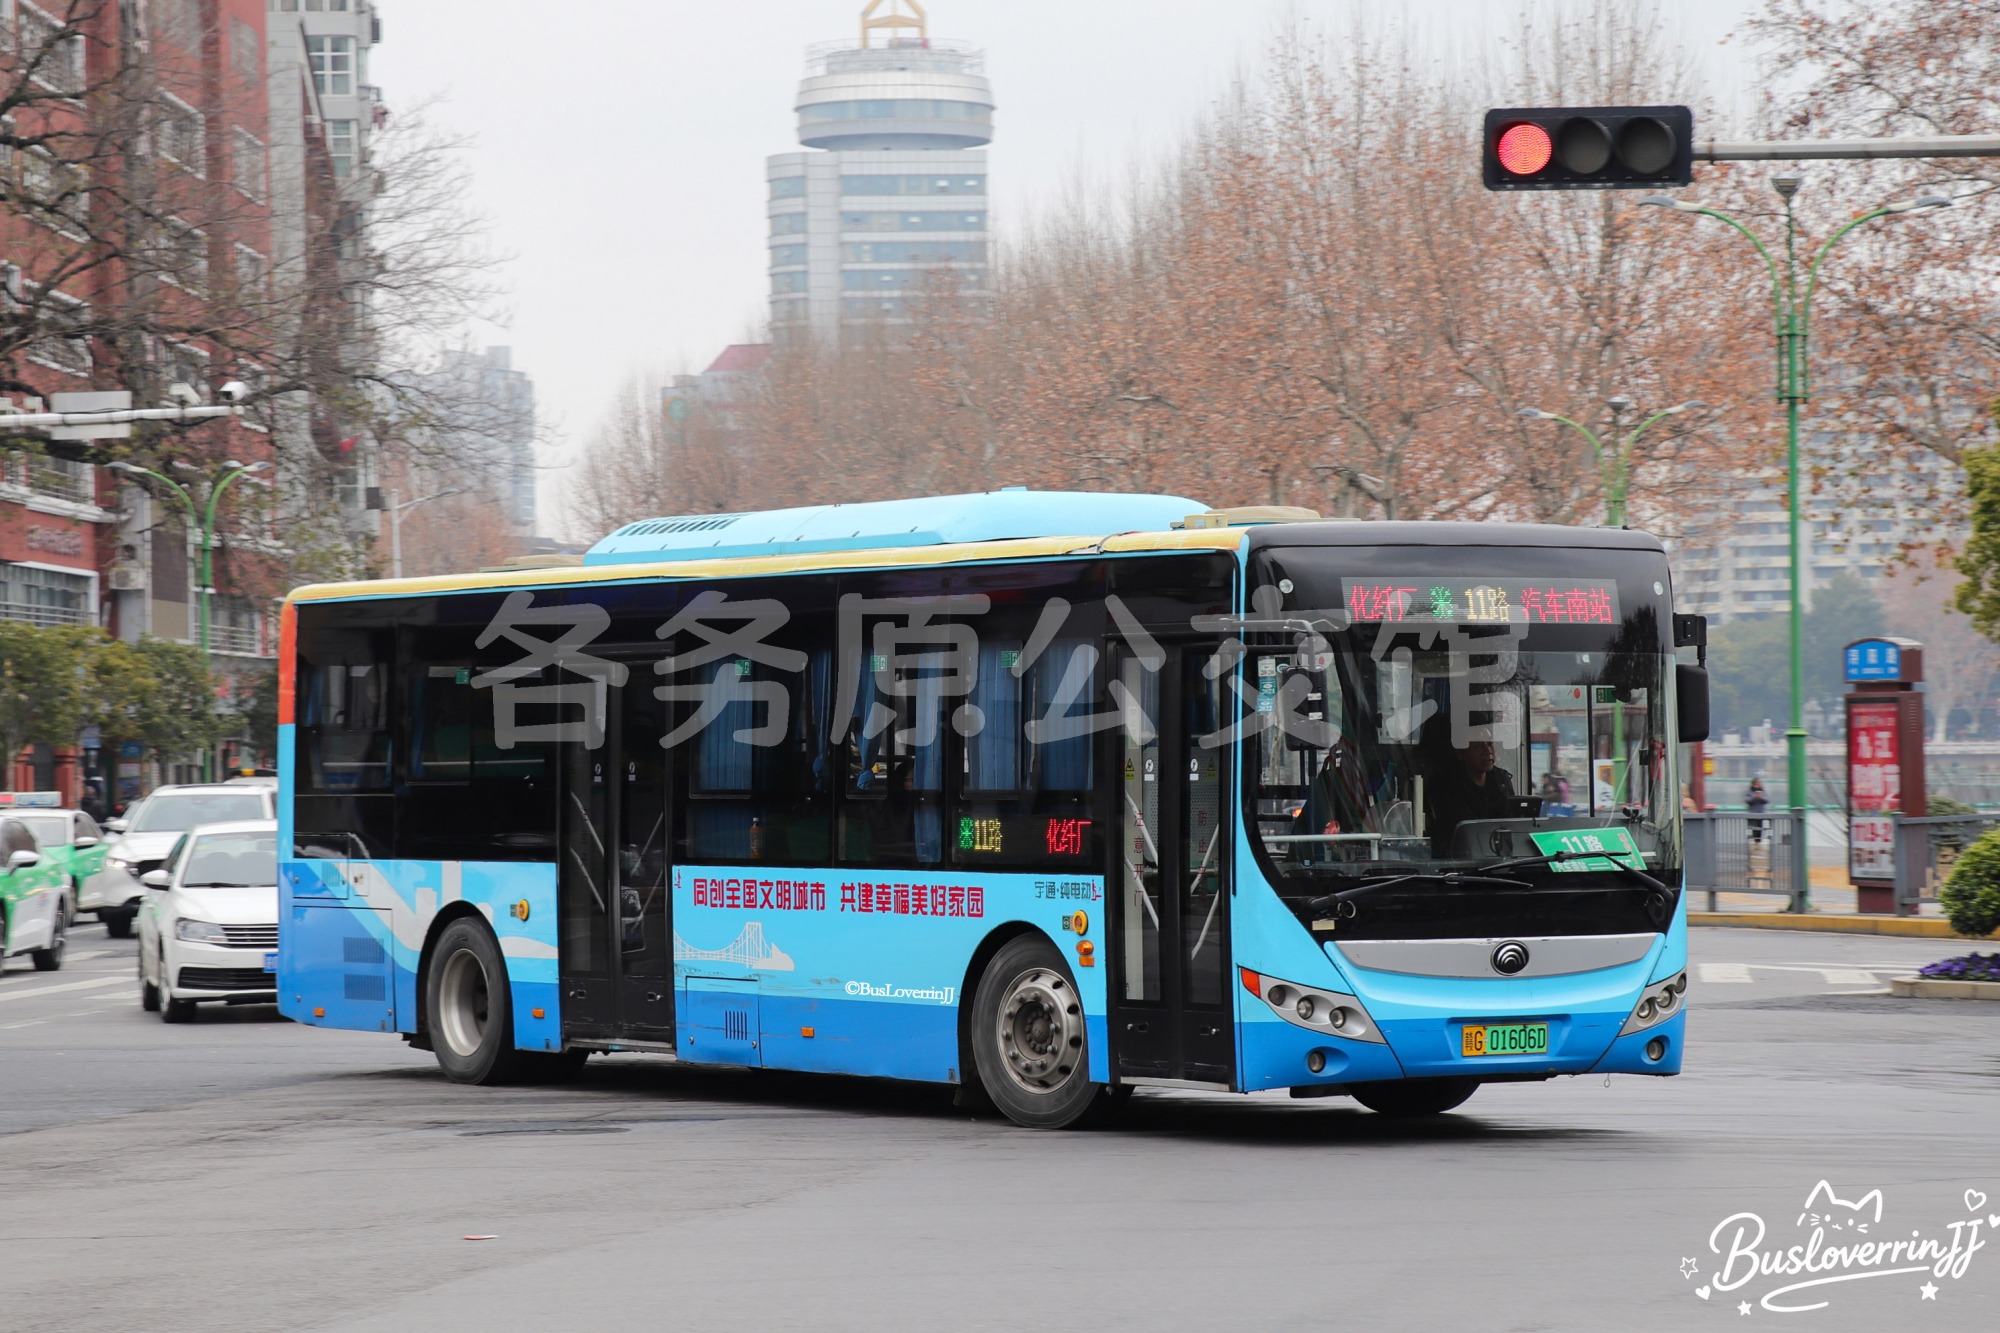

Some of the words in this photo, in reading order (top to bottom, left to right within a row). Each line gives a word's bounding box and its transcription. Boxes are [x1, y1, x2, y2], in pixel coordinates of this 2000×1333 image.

[1350, 585, 1417, 622] 化纤厂
[1464, 587, 1510, 622] 11路
[1520, 586, 1613, 623] 汽车南站
[974, 817, 1003, 853] 11路
[1046, 818, 1093, 854] 化纤厂
[1561, 835, 1605, 853] 11路
[693, 878, 826, 911] 同创全国文明城市
[840, 882, 984, 918] 共建幸福美好家园
